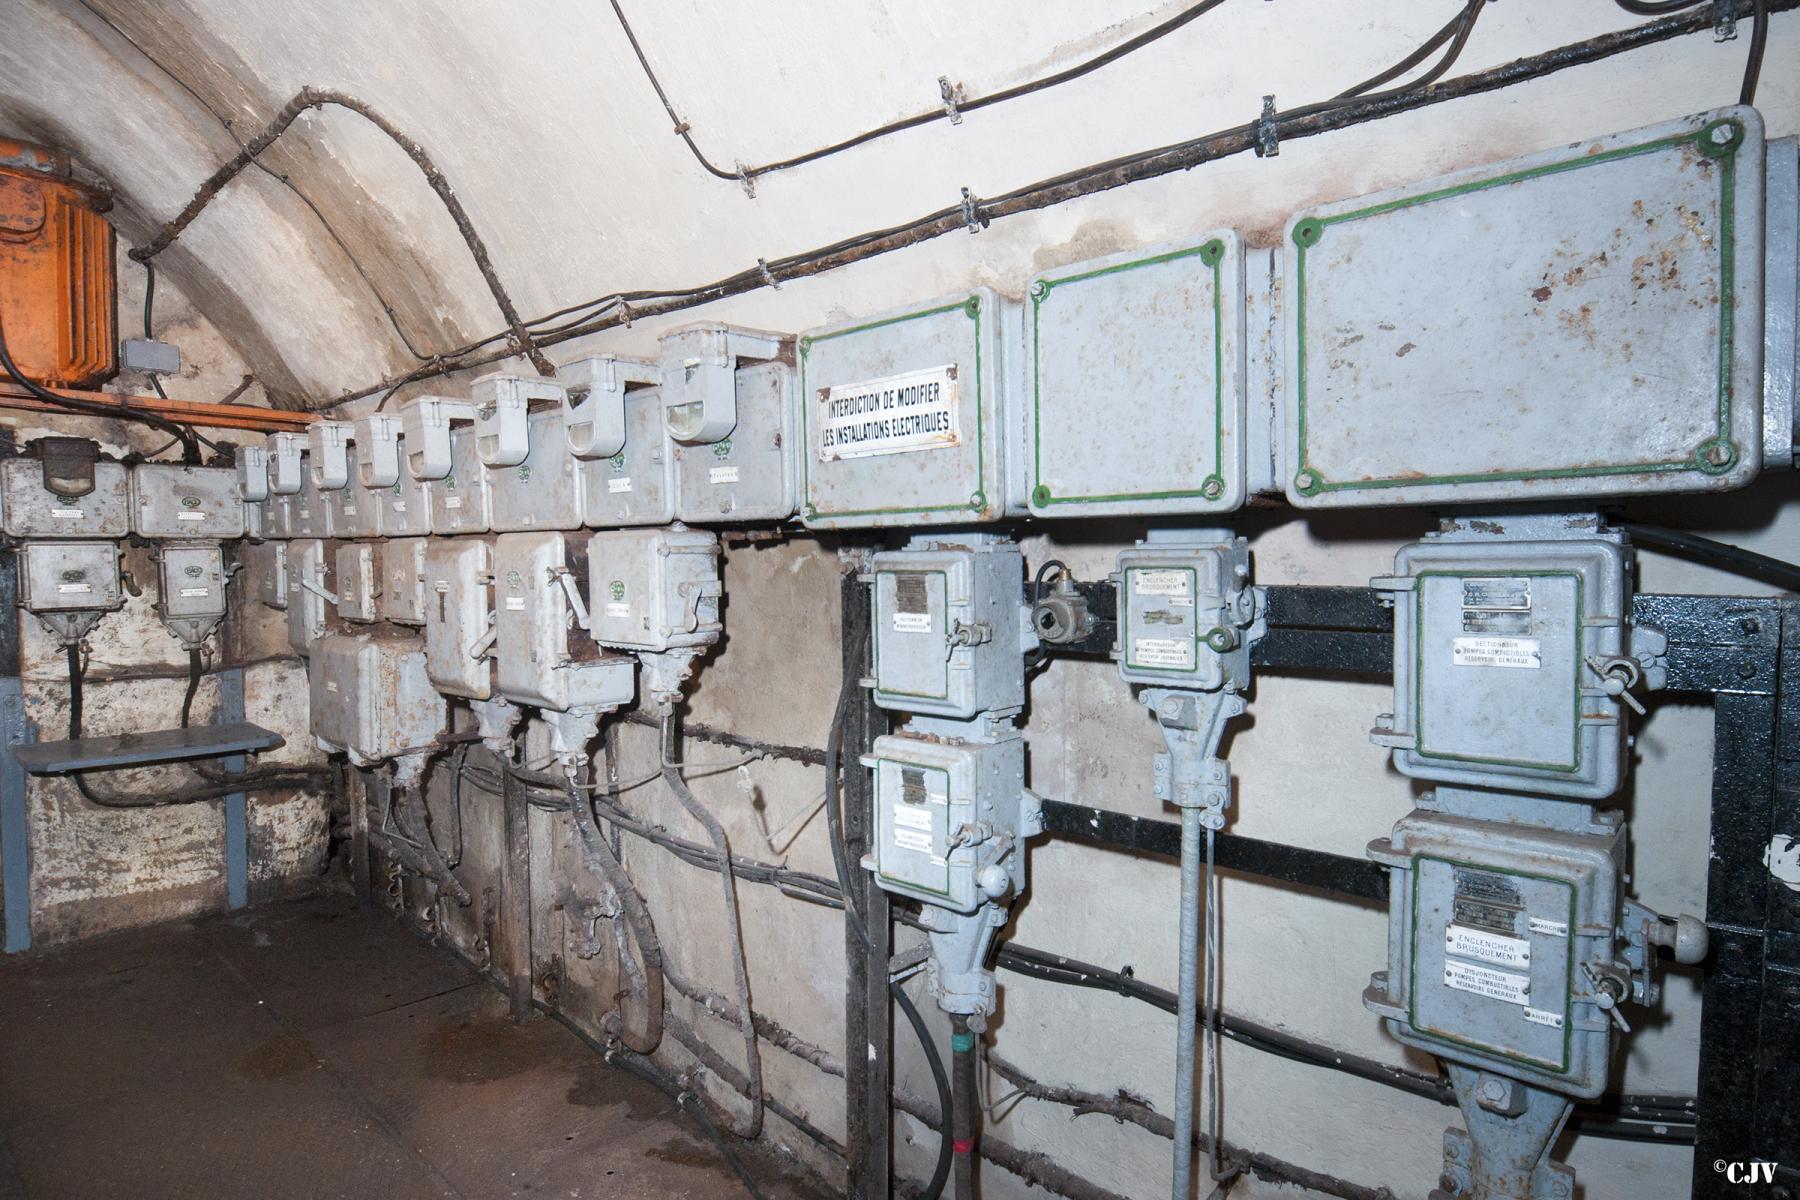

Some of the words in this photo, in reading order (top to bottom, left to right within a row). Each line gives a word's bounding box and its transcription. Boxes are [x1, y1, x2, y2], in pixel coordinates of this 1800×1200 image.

[828, 393, 879, 418] INTERDICTION
[883, 389, 894, 409] DE
[897, 382, 940, 408] MODIFIER
[822, 429, 835, 447] LES
[836, 420, 889, 445] INSTALLATIONS
[892, 411, 949, 437] ELECTRIQUES
[1456, 941, 1517, 961] BRUSQUEMENT
[1458, 935, 1514, 952] ENCLENCHER
